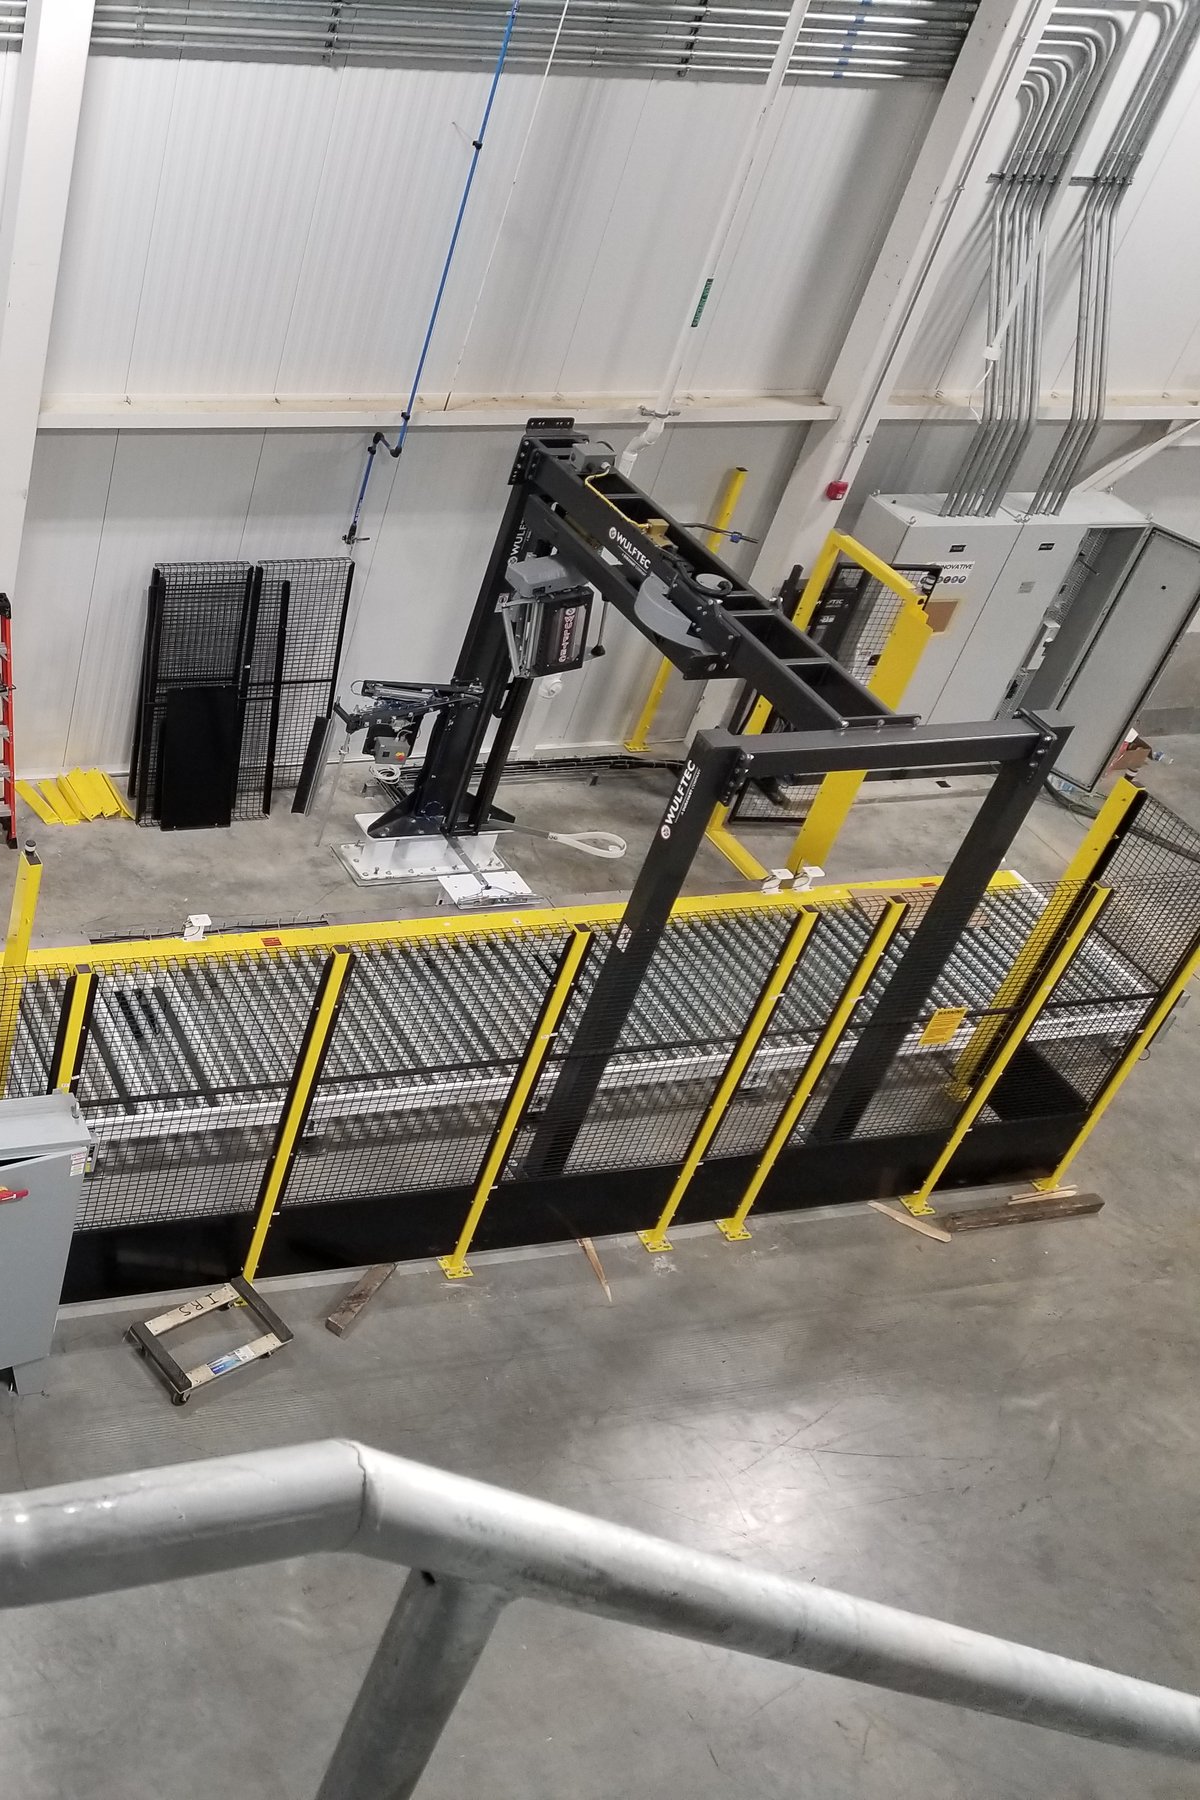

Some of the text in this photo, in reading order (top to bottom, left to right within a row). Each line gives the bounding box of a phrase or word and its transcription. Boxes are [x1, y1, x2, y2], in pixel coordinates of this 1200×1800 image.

[616, 531, 651, 570] WULFTEC
[664, 760, 696, 825] WULFTEC
[178, 1293, 220, 1318] IRS
